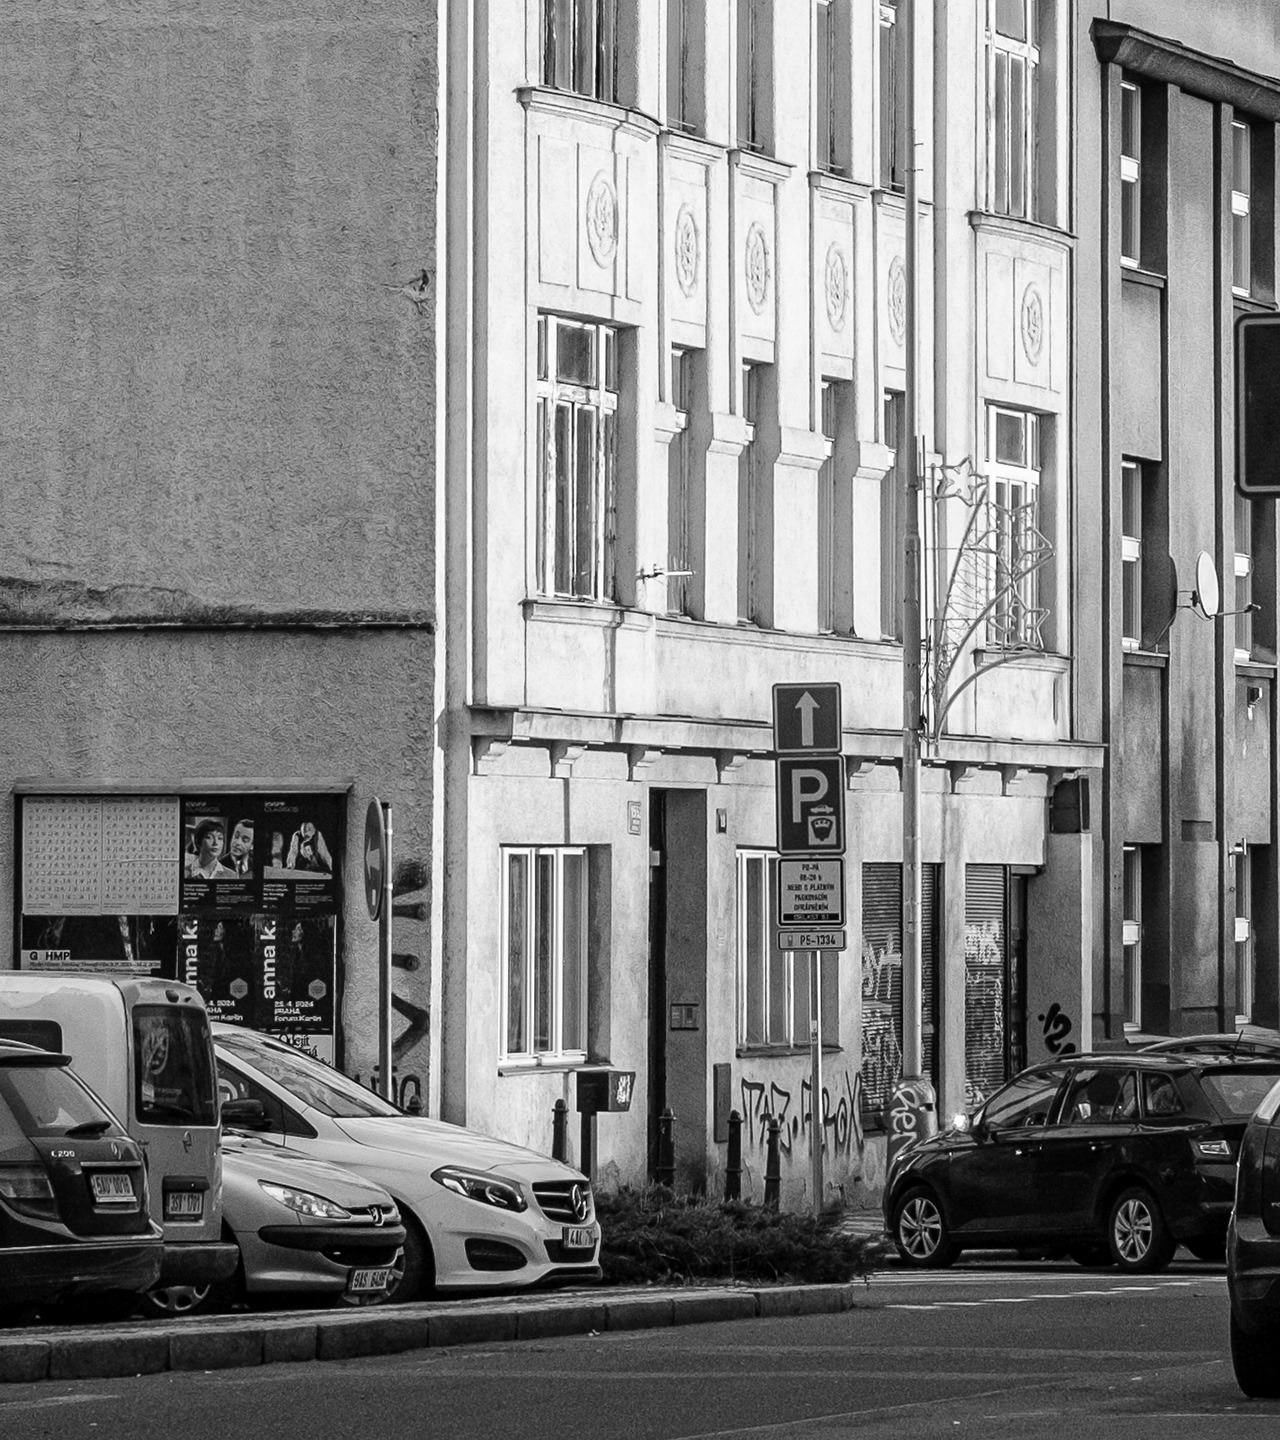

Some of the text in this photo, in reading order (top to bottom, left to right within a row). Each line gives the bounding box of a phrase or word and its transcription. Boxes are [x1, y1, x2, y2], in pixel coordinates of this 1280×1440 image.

[791, 768, 829, 823] P
[45, 951, 70, 961] HMP
[185, 944, 198, 987] nna
[260, 920, 276, 1000] anna k.
